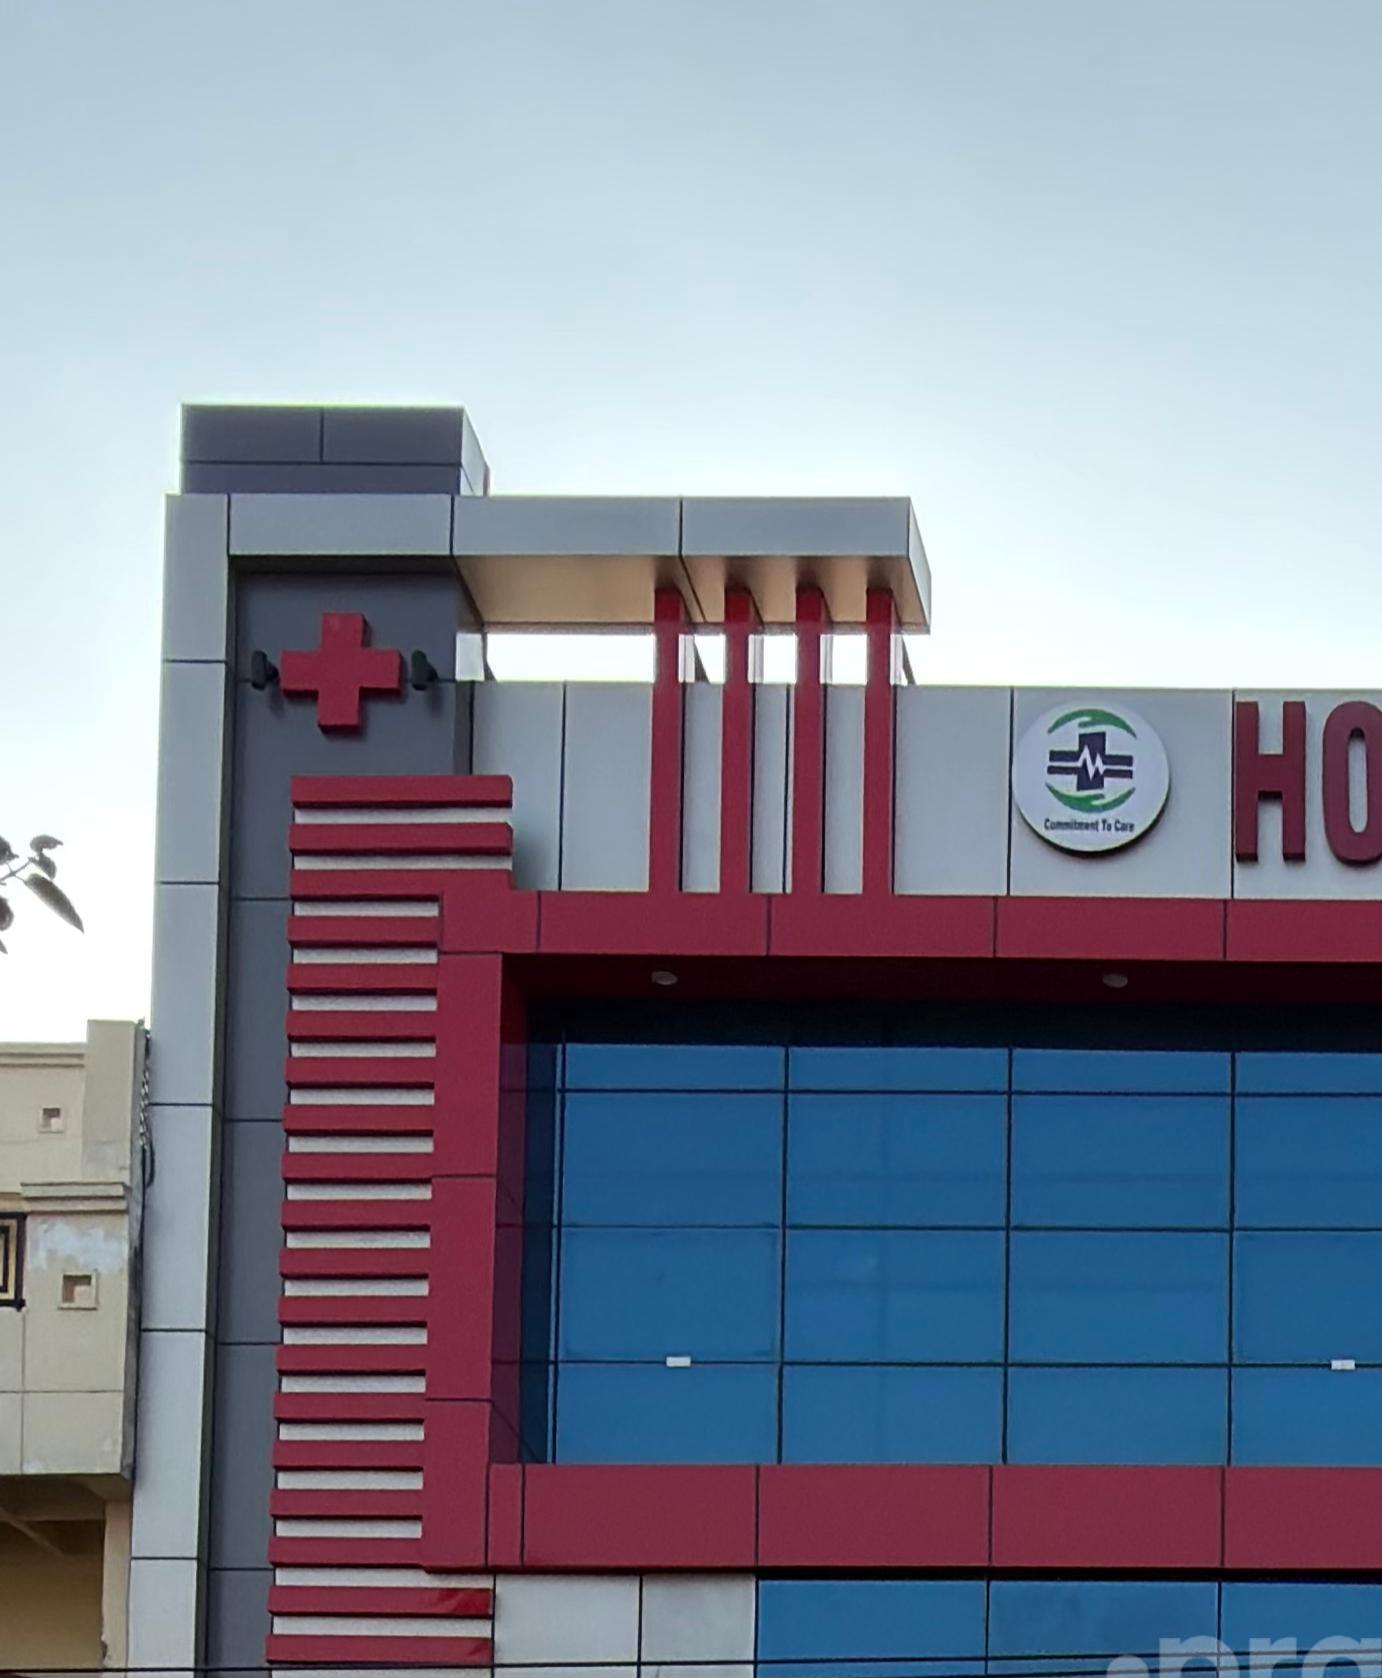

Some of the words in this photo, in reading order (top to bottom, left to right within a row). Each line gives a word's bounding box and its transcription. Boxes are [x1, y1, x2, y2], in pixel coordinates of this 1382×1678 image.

[1044, 818, 1099, 833] Commitment
[1102, 818, 1112, 831] To
[1115, 819, 1135, 833] Care
